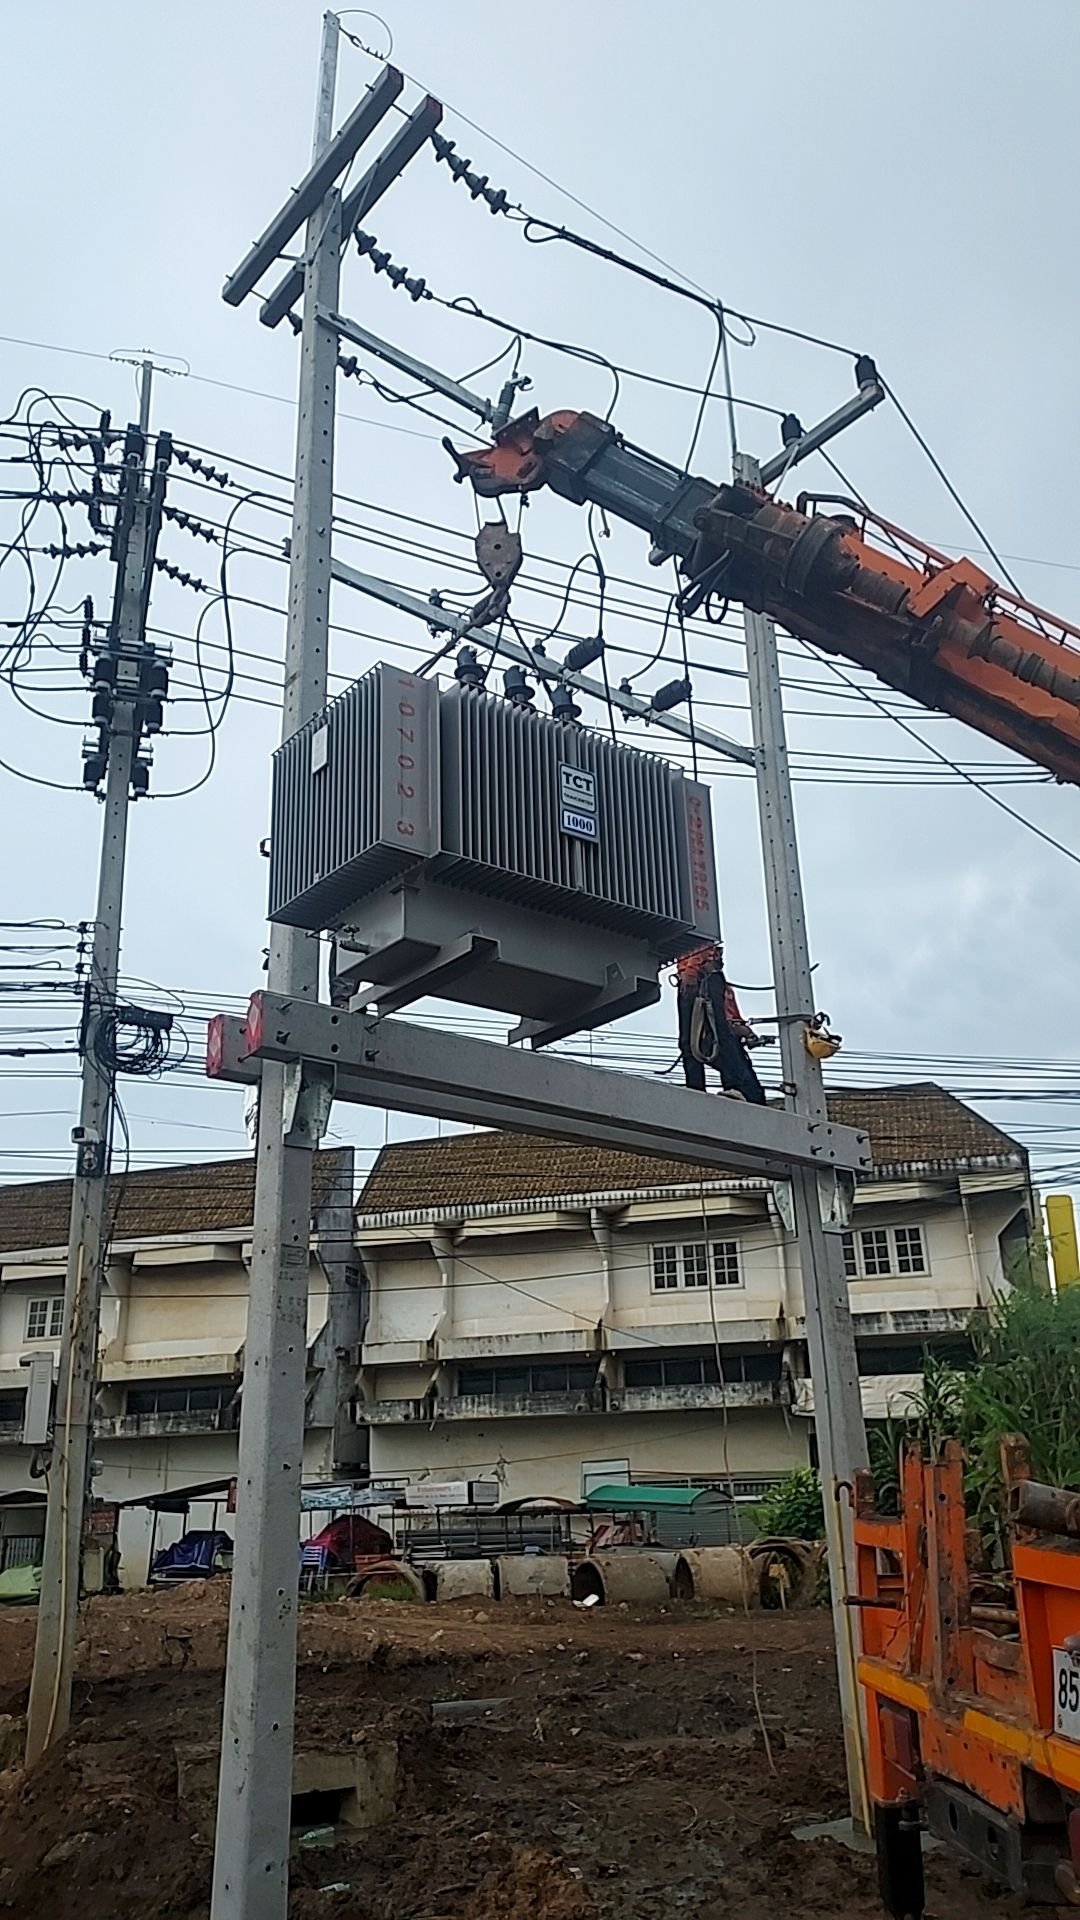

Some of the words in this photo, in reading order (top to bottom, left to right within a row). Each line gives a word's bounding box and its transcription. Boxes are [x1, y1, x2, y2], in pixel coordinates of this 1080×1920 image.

[562, 770, 593, 791] TCT
[566, 814, 593, 832] 1000
[1058, 1667, 1079, 1713] 85
